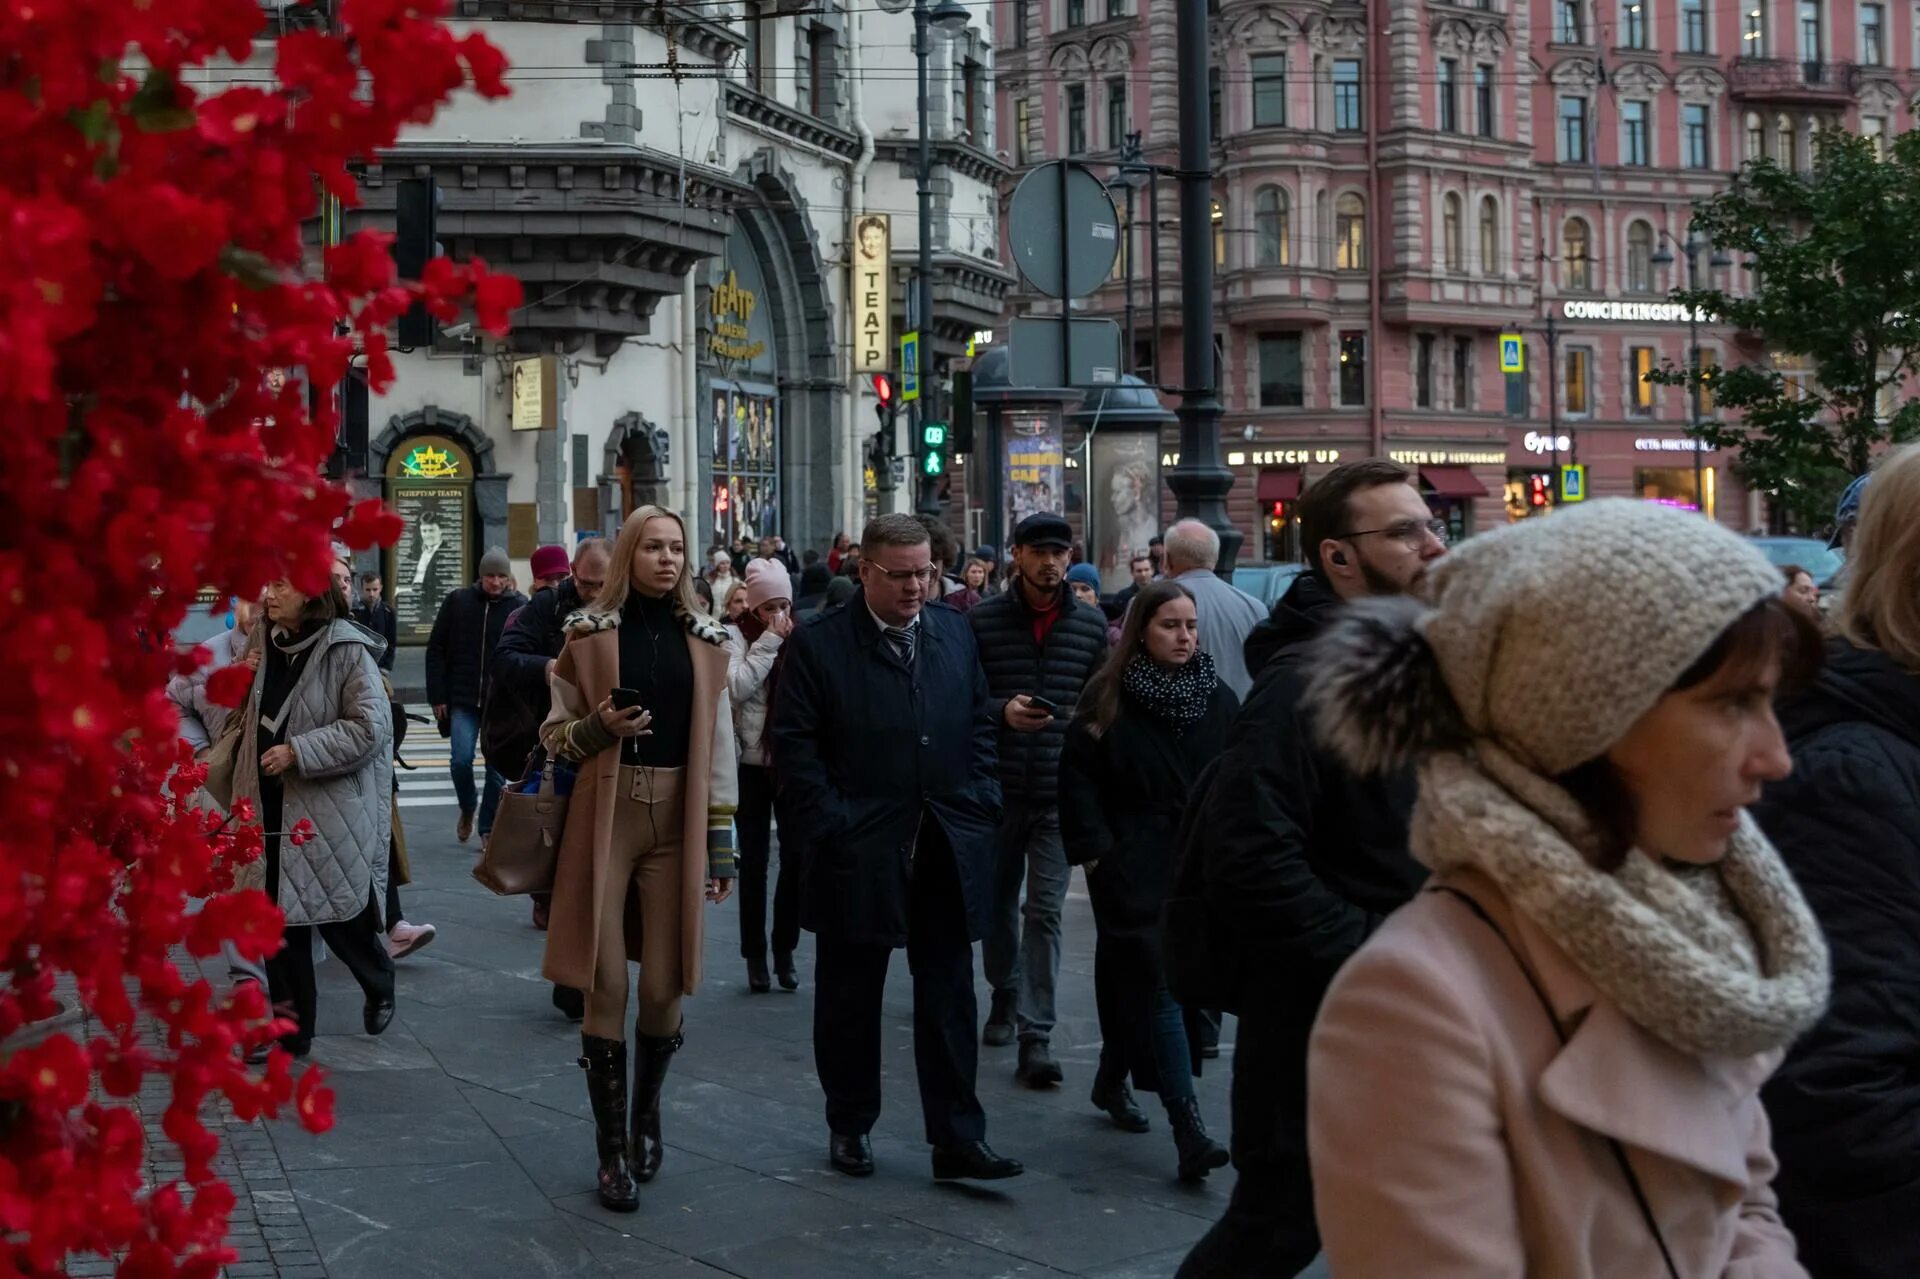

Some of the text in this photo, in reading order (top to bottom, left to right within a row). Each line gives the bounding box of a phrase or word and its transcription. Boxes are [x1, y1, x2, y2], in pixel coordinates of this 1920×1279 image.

[711, 270, 755, 321] ТЕАТР
[864, 272, 880, 367] ТЕАТР
[1252, 450, 1340, 464] KETCH UP
[398, 490, 462, 498] РЕПЕРТУАР ТЕАТРА
